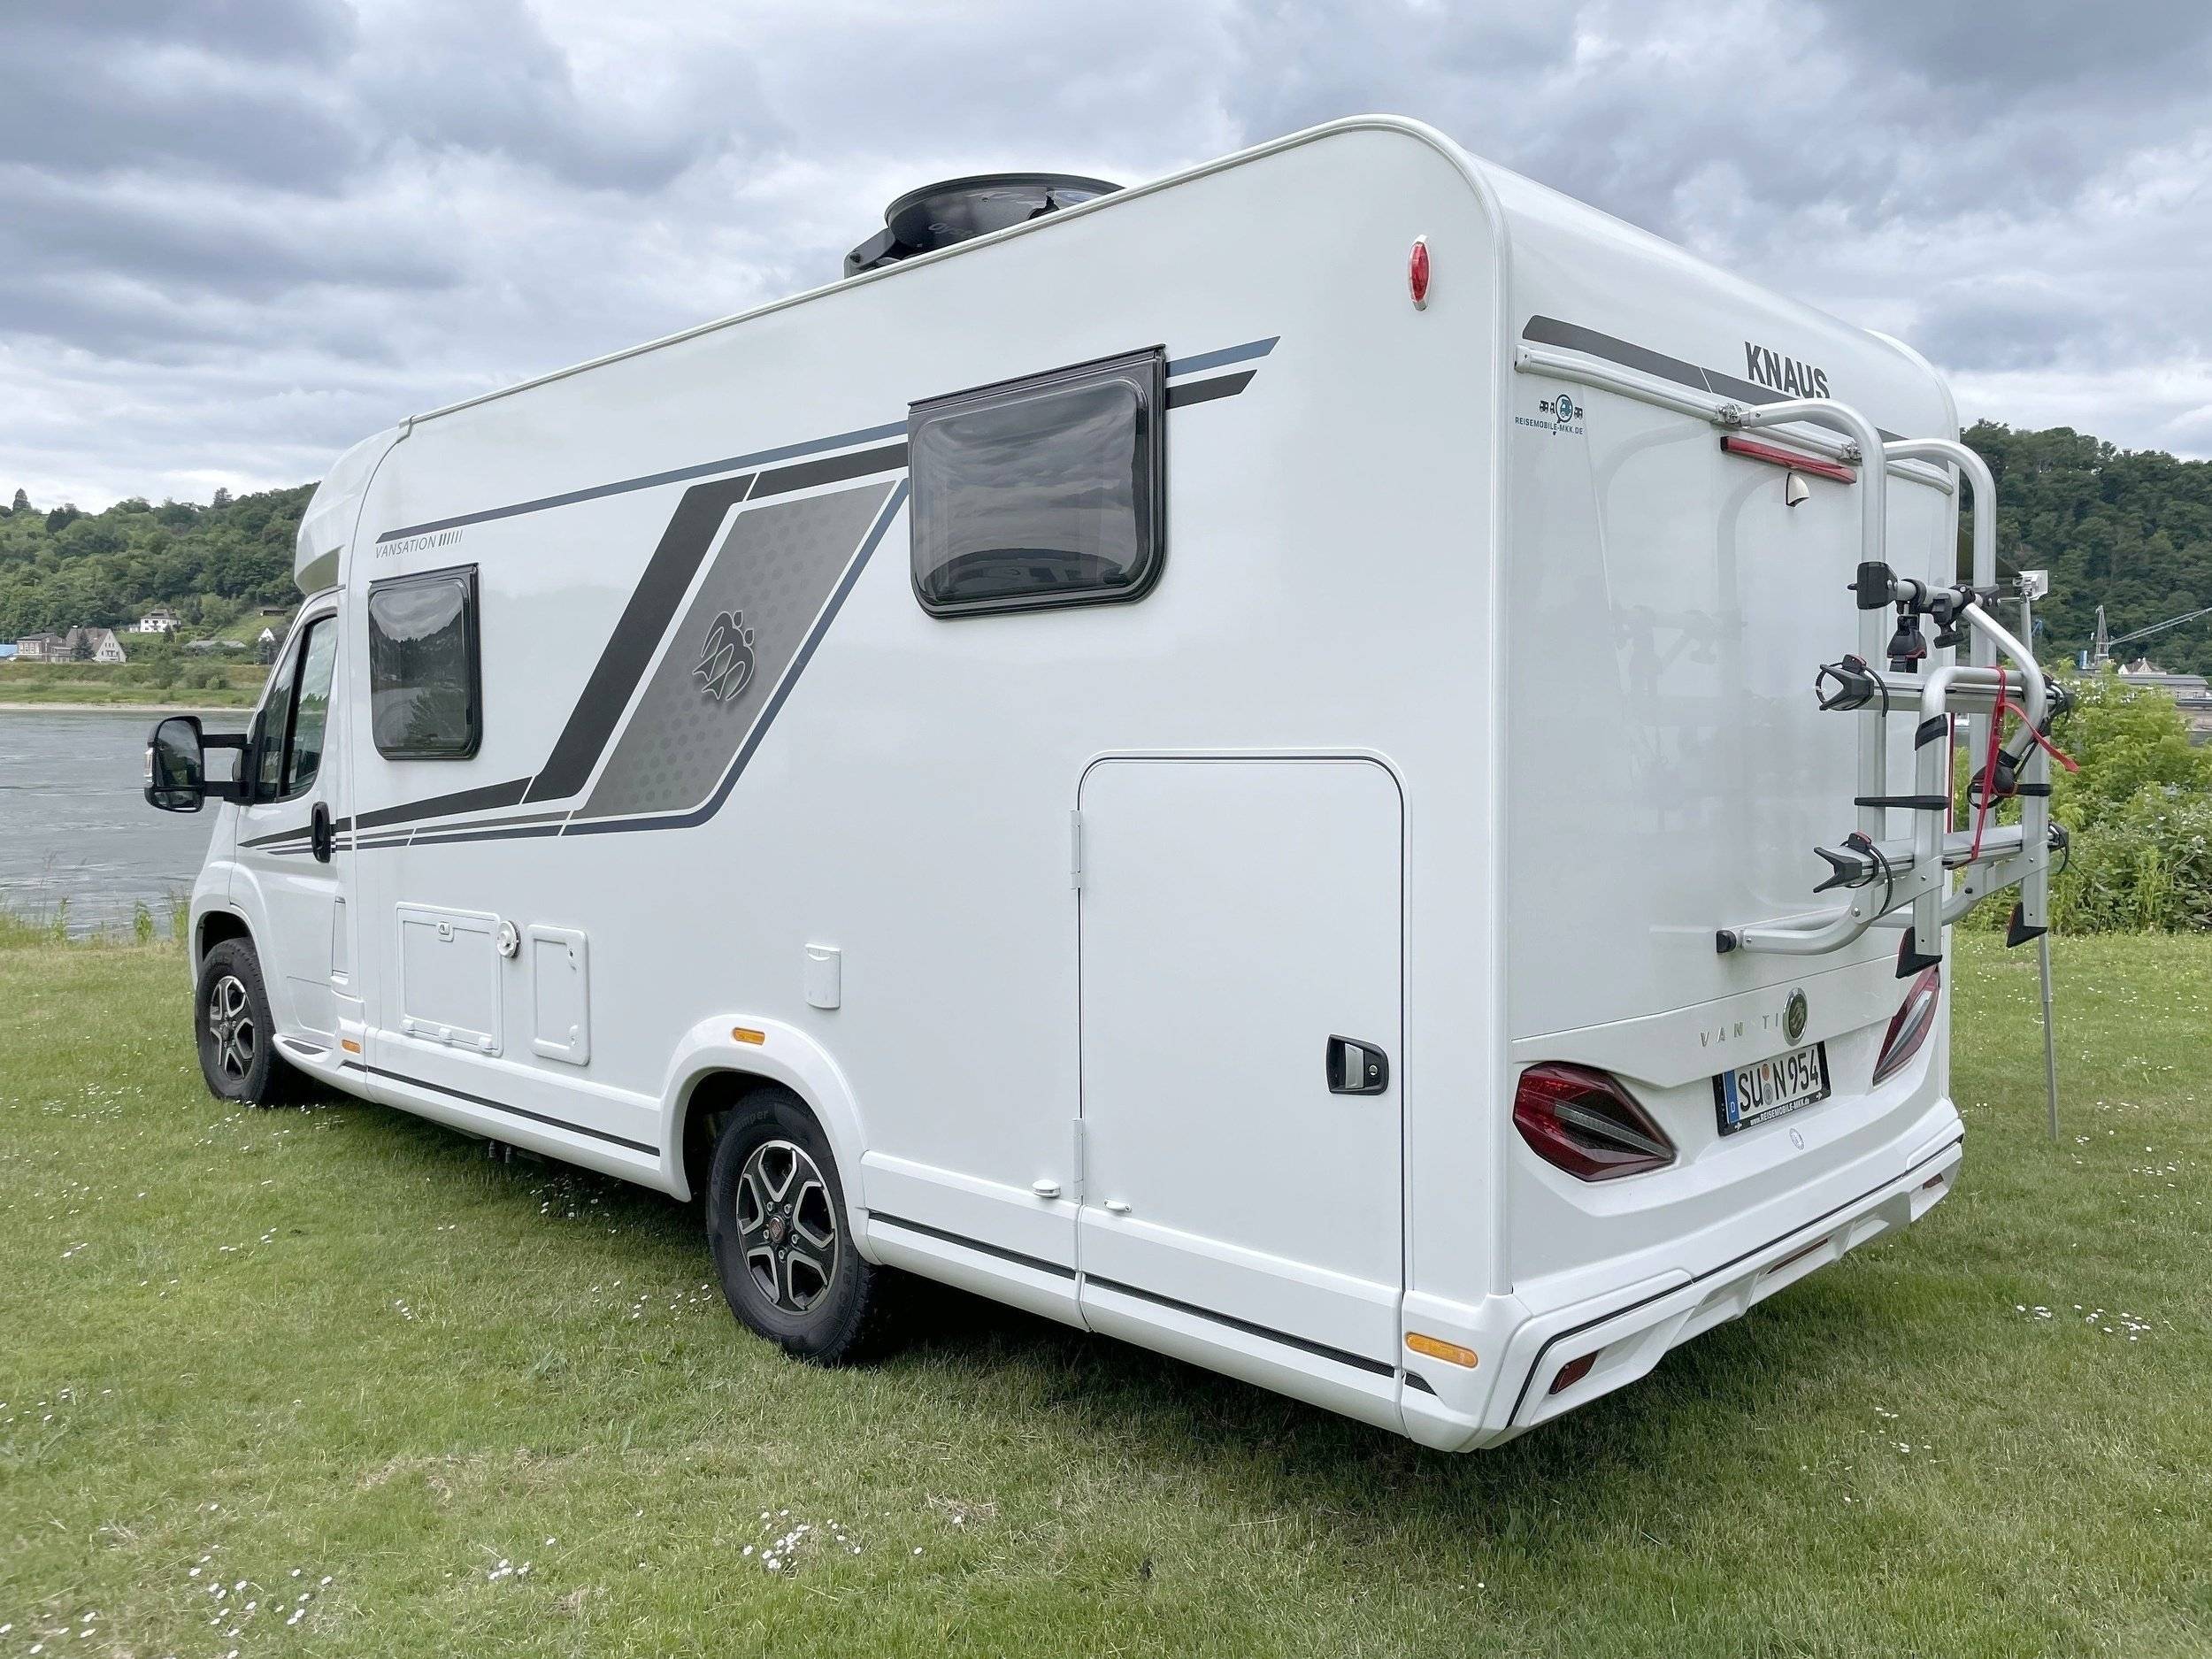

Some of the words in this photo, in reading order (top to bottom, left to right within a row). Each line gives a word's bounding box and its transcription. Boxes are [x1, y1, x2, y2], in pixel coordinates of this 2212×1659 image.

[1745, 342, 1831, 399] KNAUS
[1515, 416, 1584, 434] REISEMOBILE-MKK.DE
[375, 535, 437, 558] VANSATION
[1738, 1067, 1764, 1112] SU
[1772, 1060, 1787, 1101] N
[1787, 1048, 1819, 1094] 954
[1729, 1101, 1735, 1113] D
